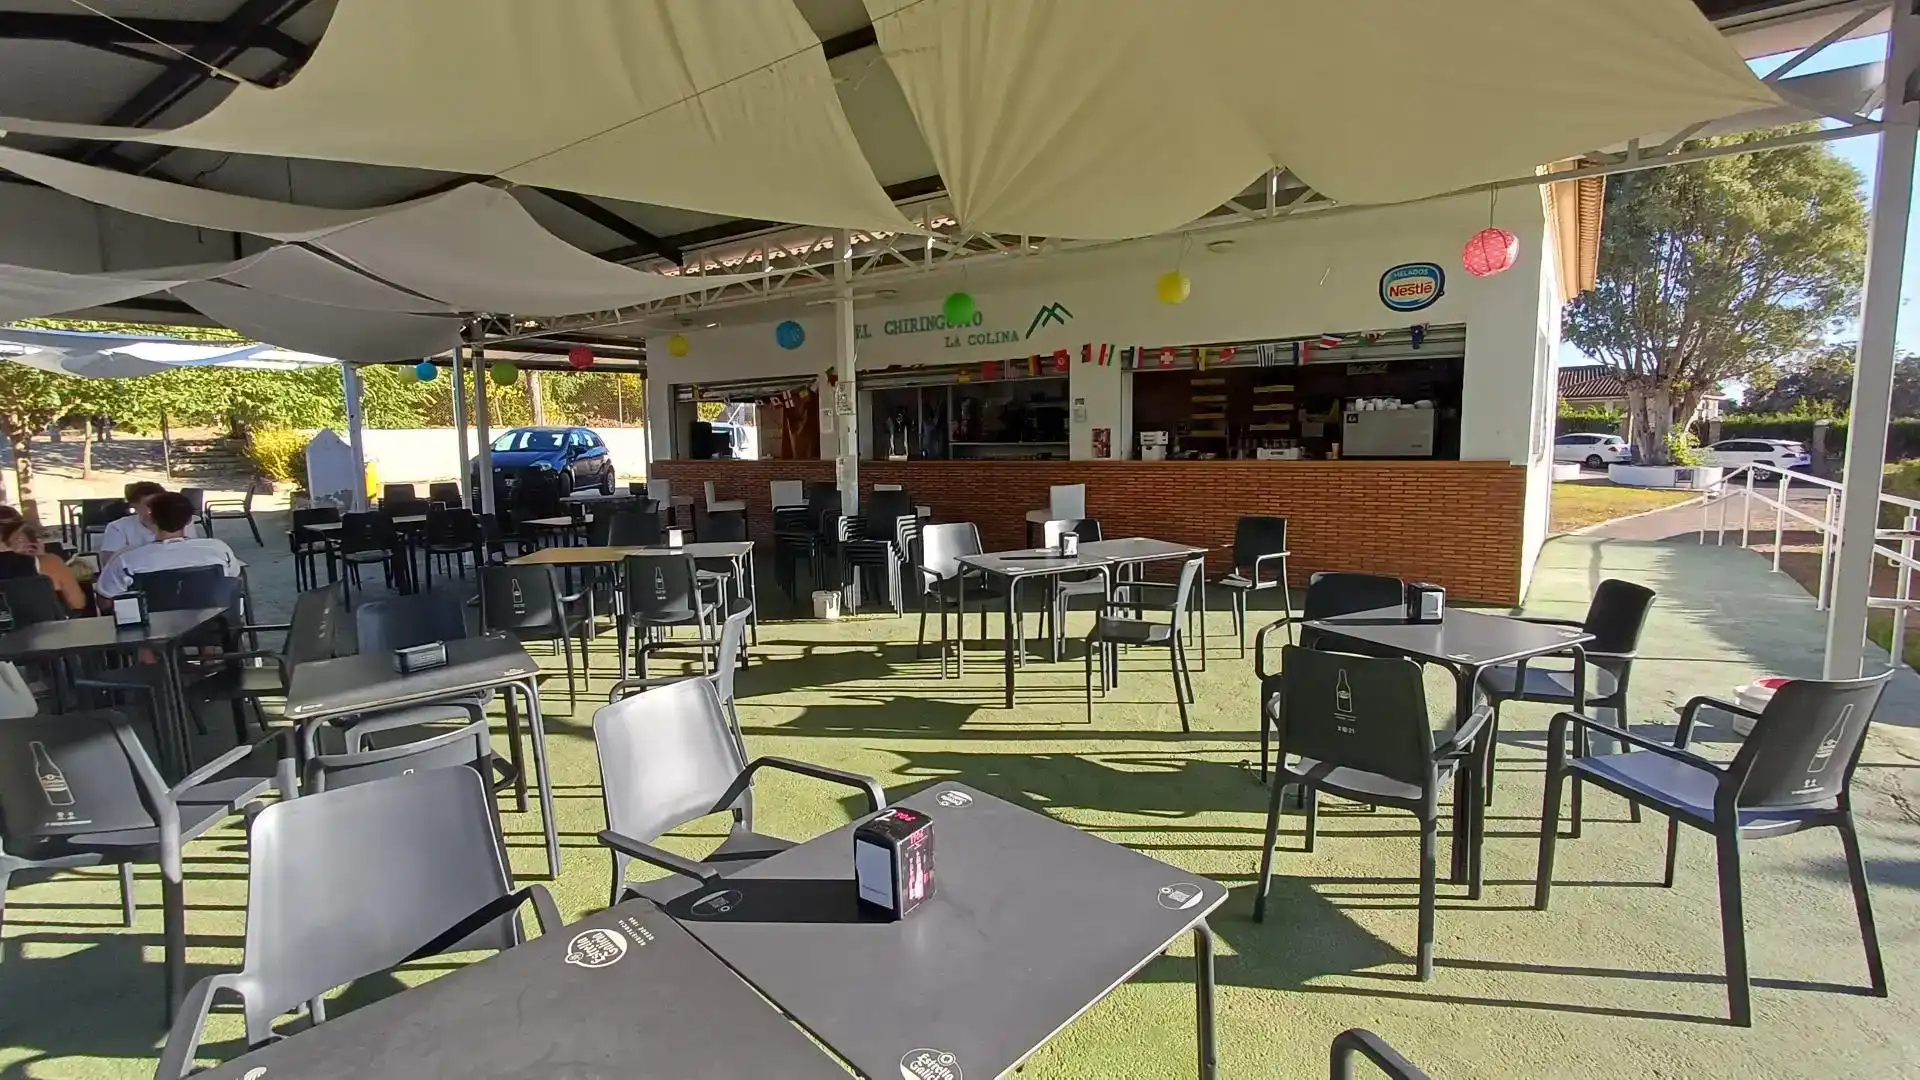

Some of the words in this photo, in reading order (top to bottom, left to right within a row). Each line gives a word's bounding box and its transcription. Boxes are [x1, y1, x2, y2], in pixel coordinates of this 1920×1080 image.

[1393, 268, 1429, 277] HELADOS
[855, 324, 872, 340] EL
[884, 311, 983, 335] CHIRINGO
[944, 334, 962, 348] LA
[968, 330, 1020, 346] COLINA
